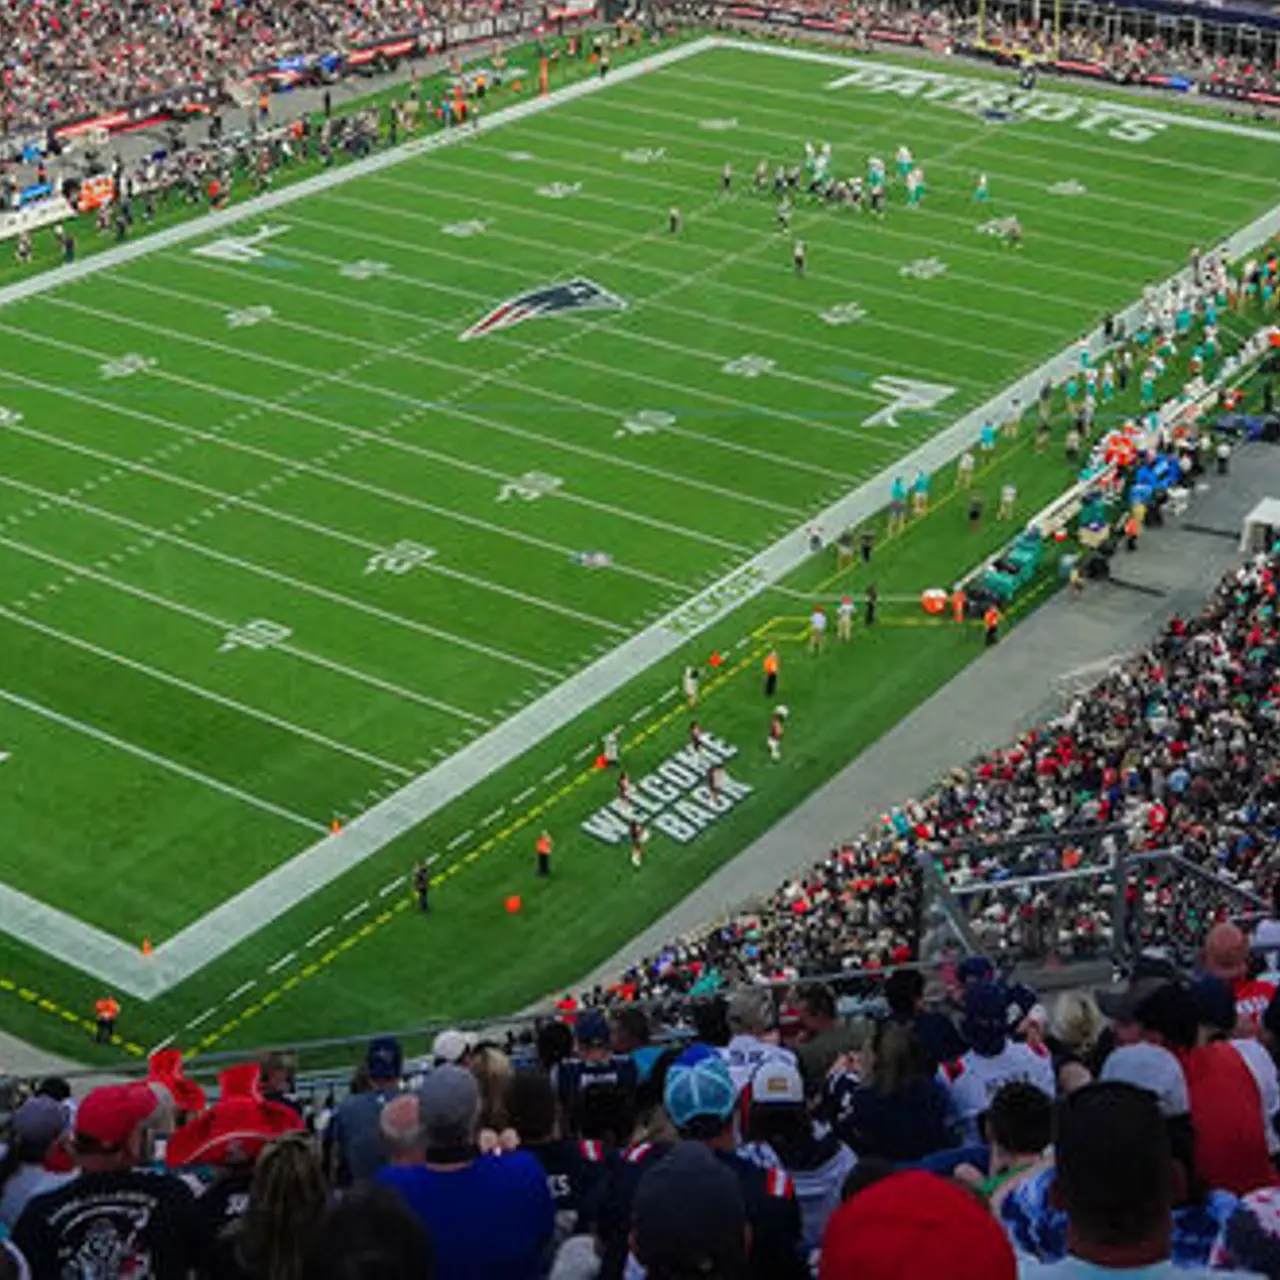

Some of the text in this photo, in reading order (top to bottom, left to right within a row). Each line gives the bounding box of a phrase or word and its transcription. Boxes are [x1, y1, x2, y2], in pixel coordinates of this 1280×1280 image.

[825, 69, 1171, 142] PATRIOTS
[580, 731, 739, 844] WELCOME
[652, 767, 755, 843] BACK
